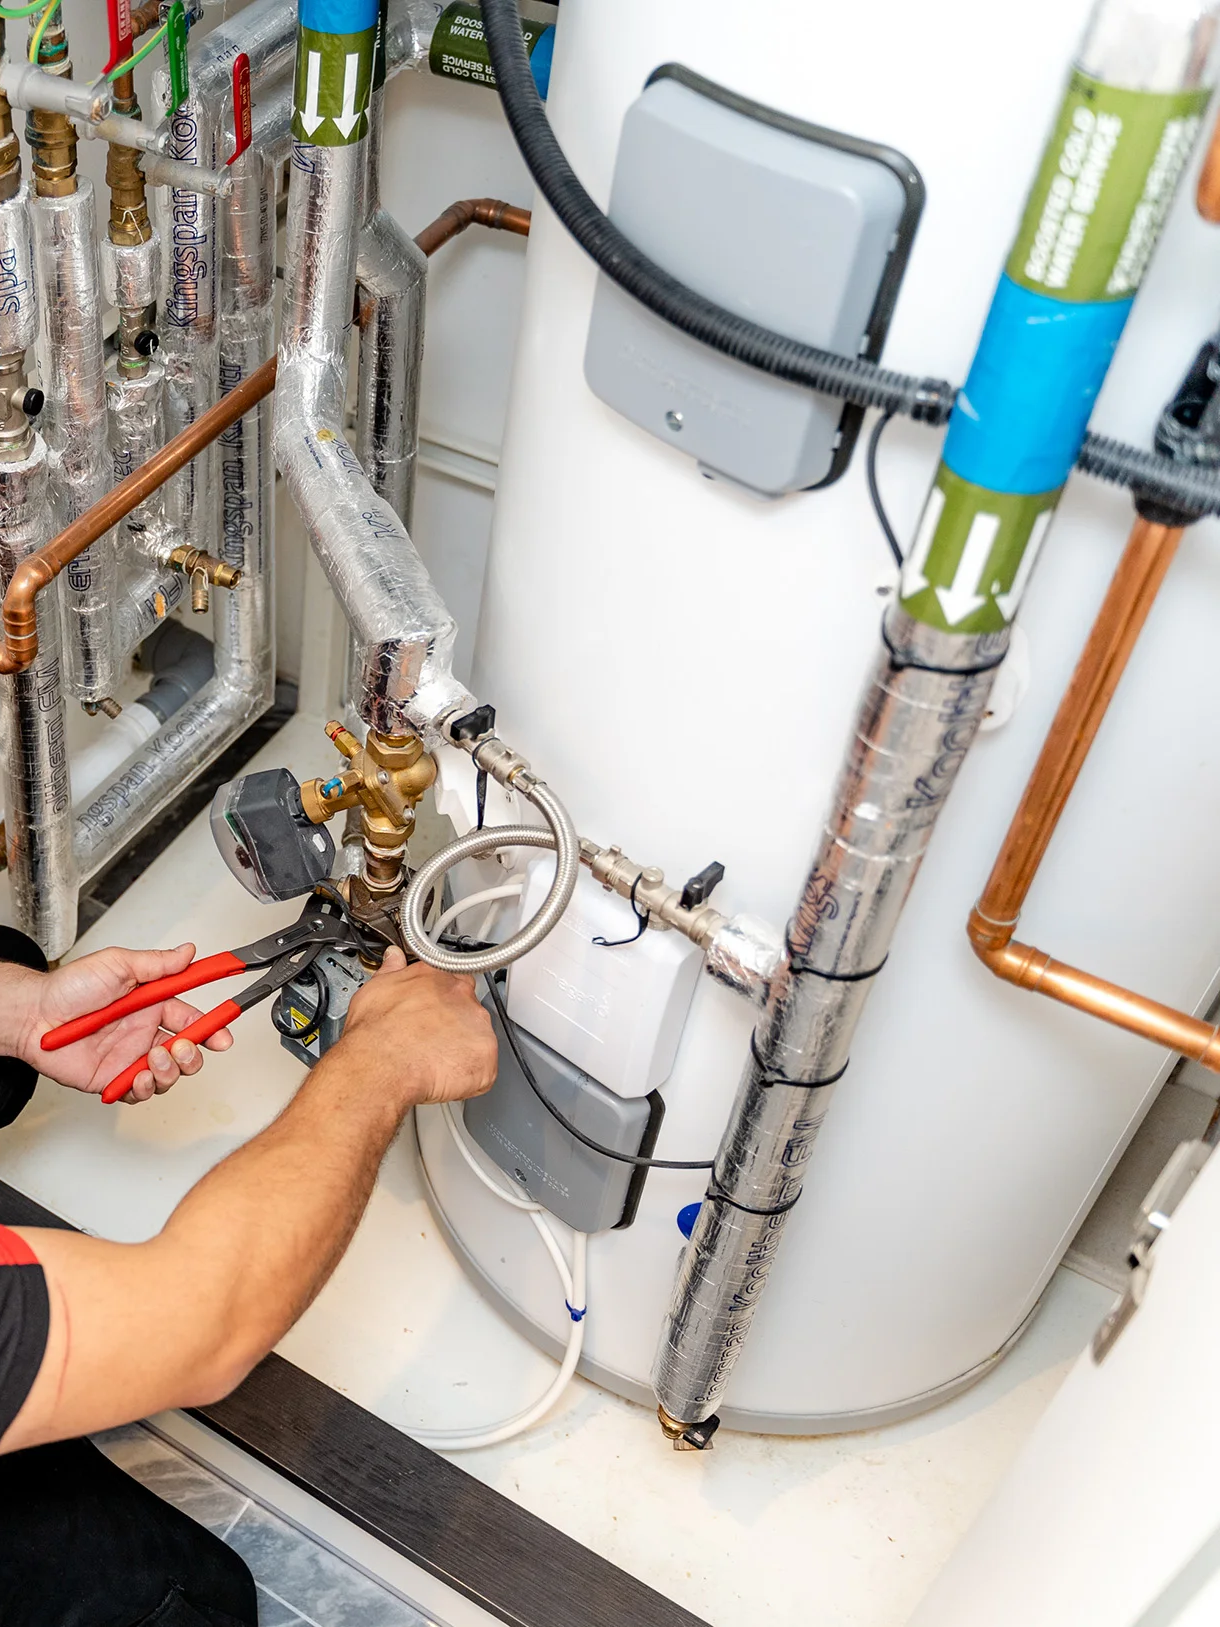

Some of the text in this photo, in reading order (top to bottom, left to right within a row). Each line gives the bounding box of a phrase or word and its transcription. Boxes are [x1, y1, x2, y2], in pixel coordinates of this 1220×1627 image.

[454, 16, 484, 30] BOOS
[449, 25, 483, 40] WATER
[442, 54, 484, 72] SERVICE
[442, 65, 469, 78] COLD
[471, 71, 497, 84] STED
[1024, 106, 1096, 283] BOOSTED COLD
[1044, 111, 1123, 288] WATER SERVICE
